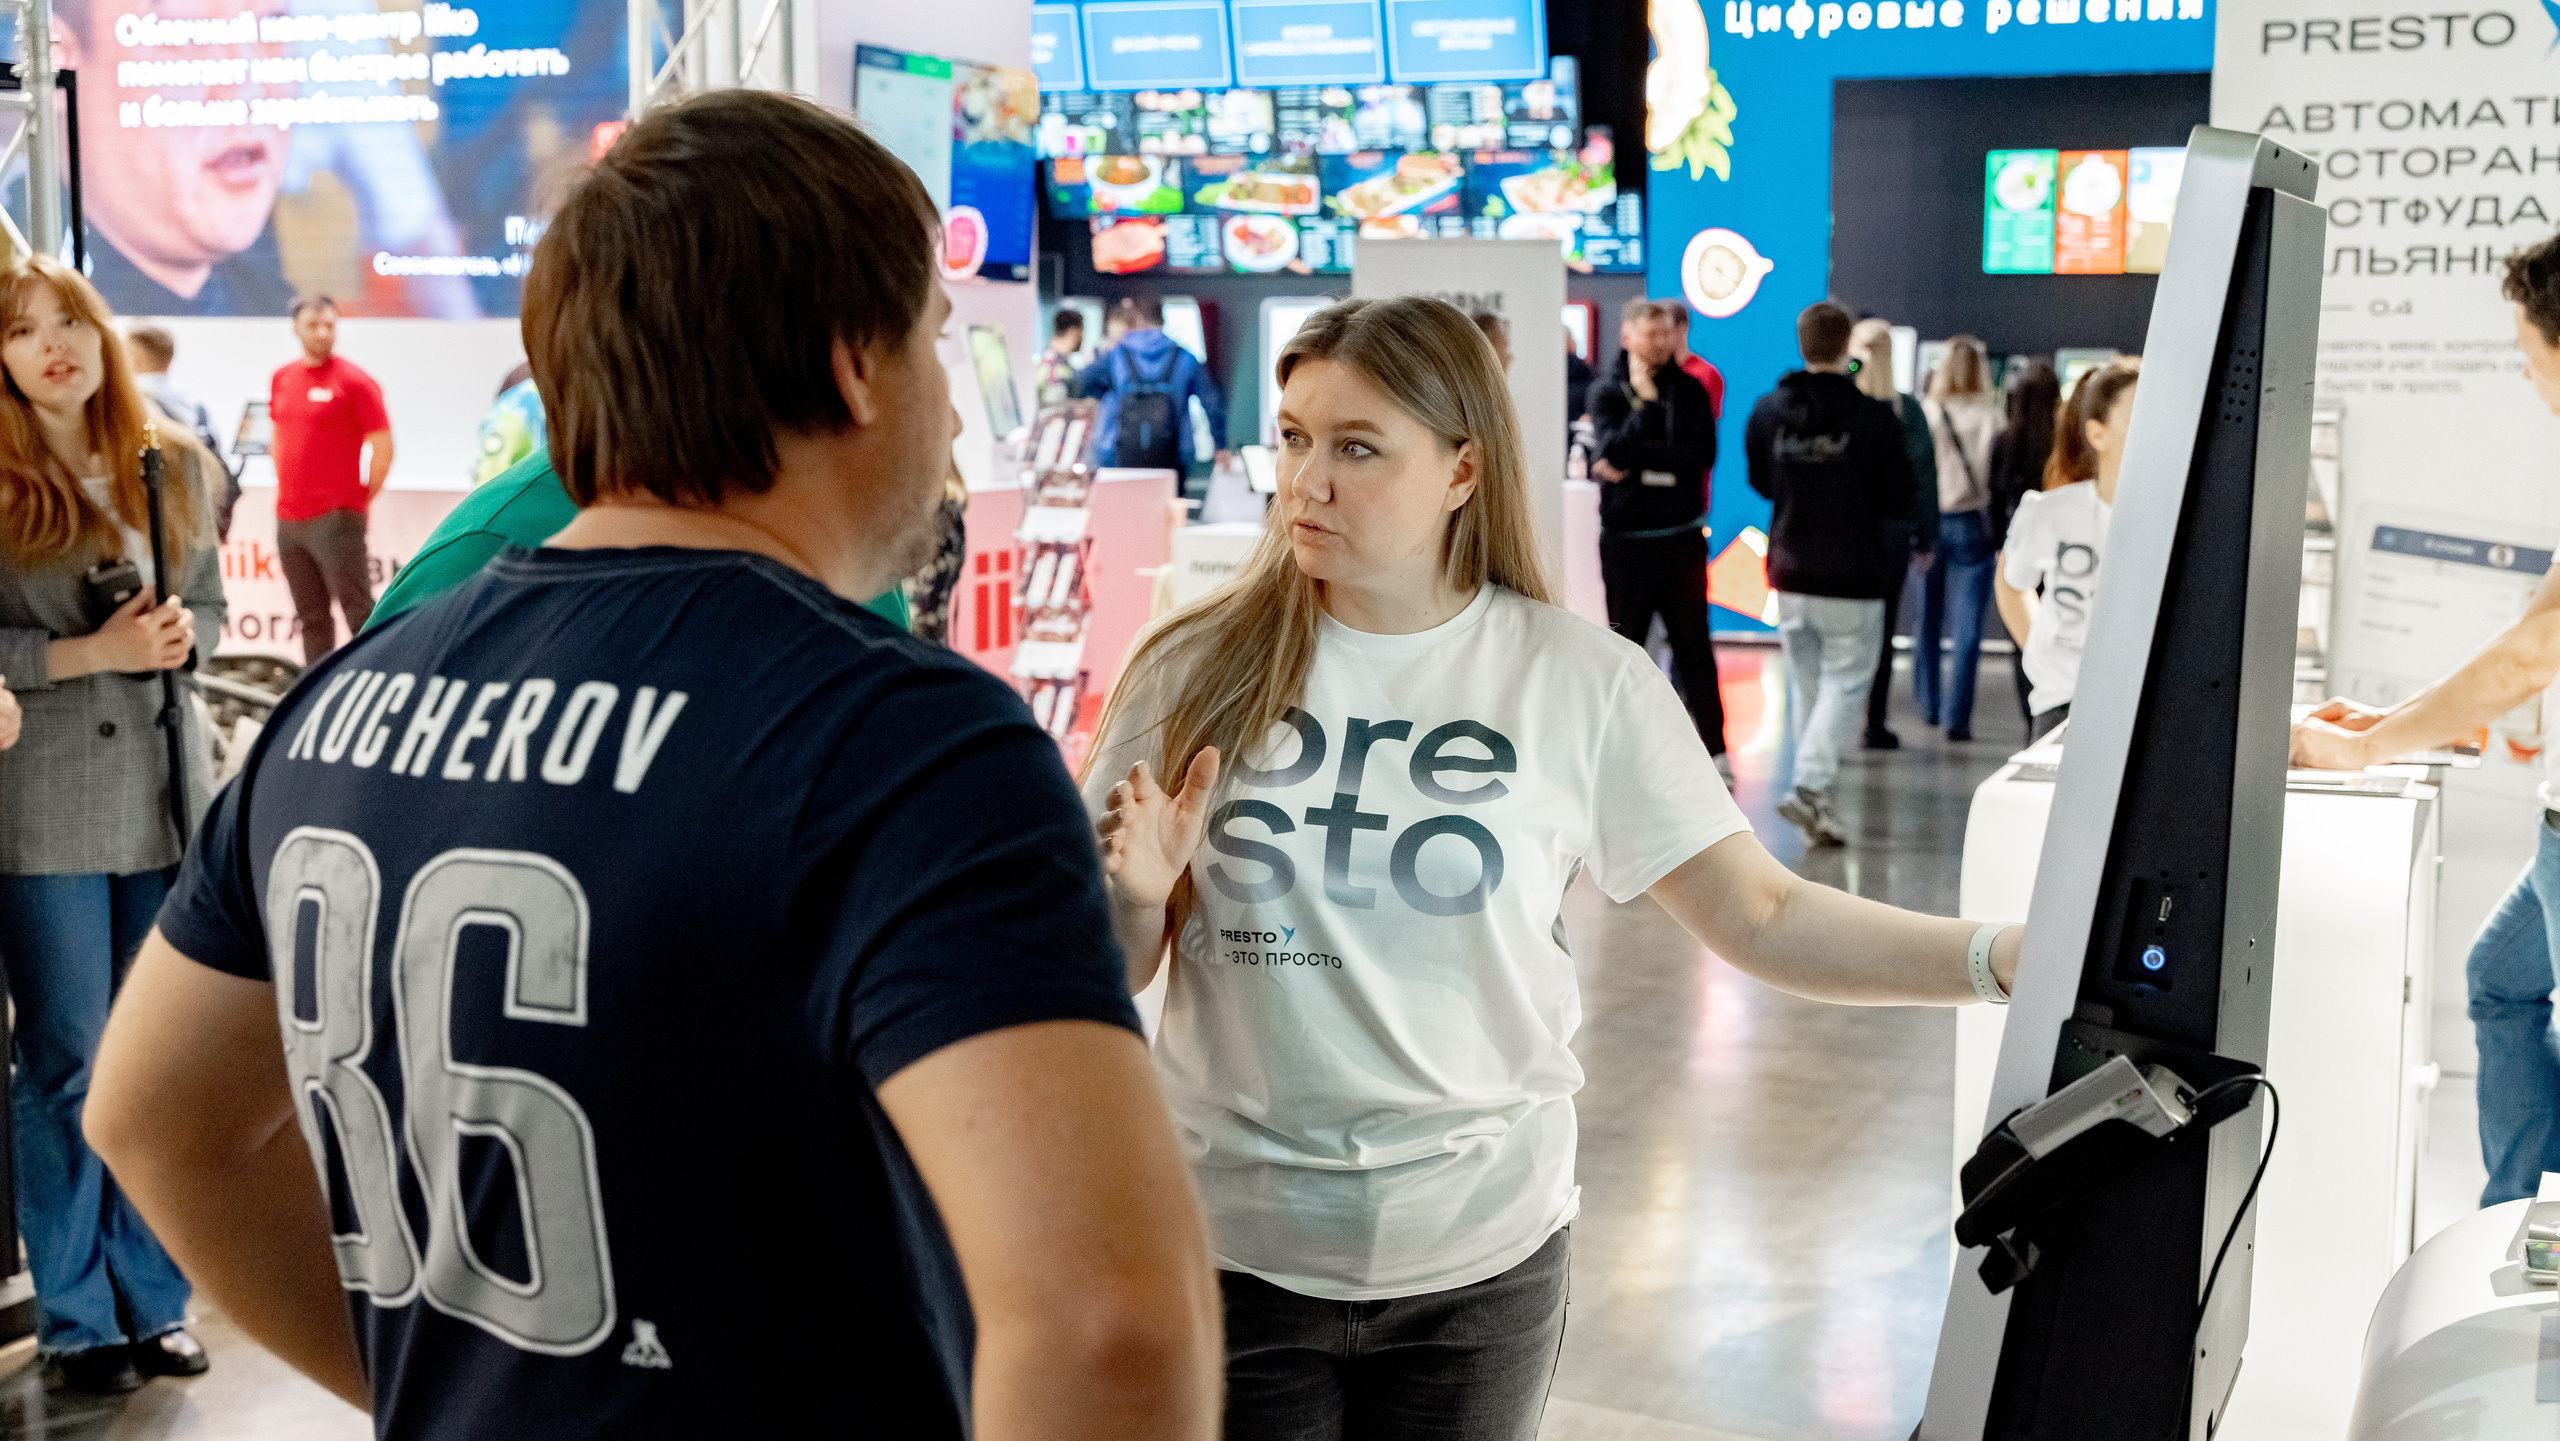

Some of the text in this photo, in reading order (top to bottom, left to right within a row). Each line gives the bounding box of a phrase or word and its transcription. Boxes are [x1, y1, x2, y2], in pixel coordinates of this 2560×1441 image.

[2261, 11, 2517, 56] PRESTO
[2258, 97, 2560, 134] АВТОМАТ
[2307, 146, 2560, 180] СТОРАН
[2328, 193, 2560, 229] СТФУДА
[2325, 245, 2516, 276] ЛЬЯНН
[287, 669, 689, 794] KUCHEROV
[1206, 792, 1505, 917] sto
[1220, 928, 1278, 944] PRESTO
[1266, 952, 1342, 969] ПРОСТО
[267, 825, 617, 1358] 86
